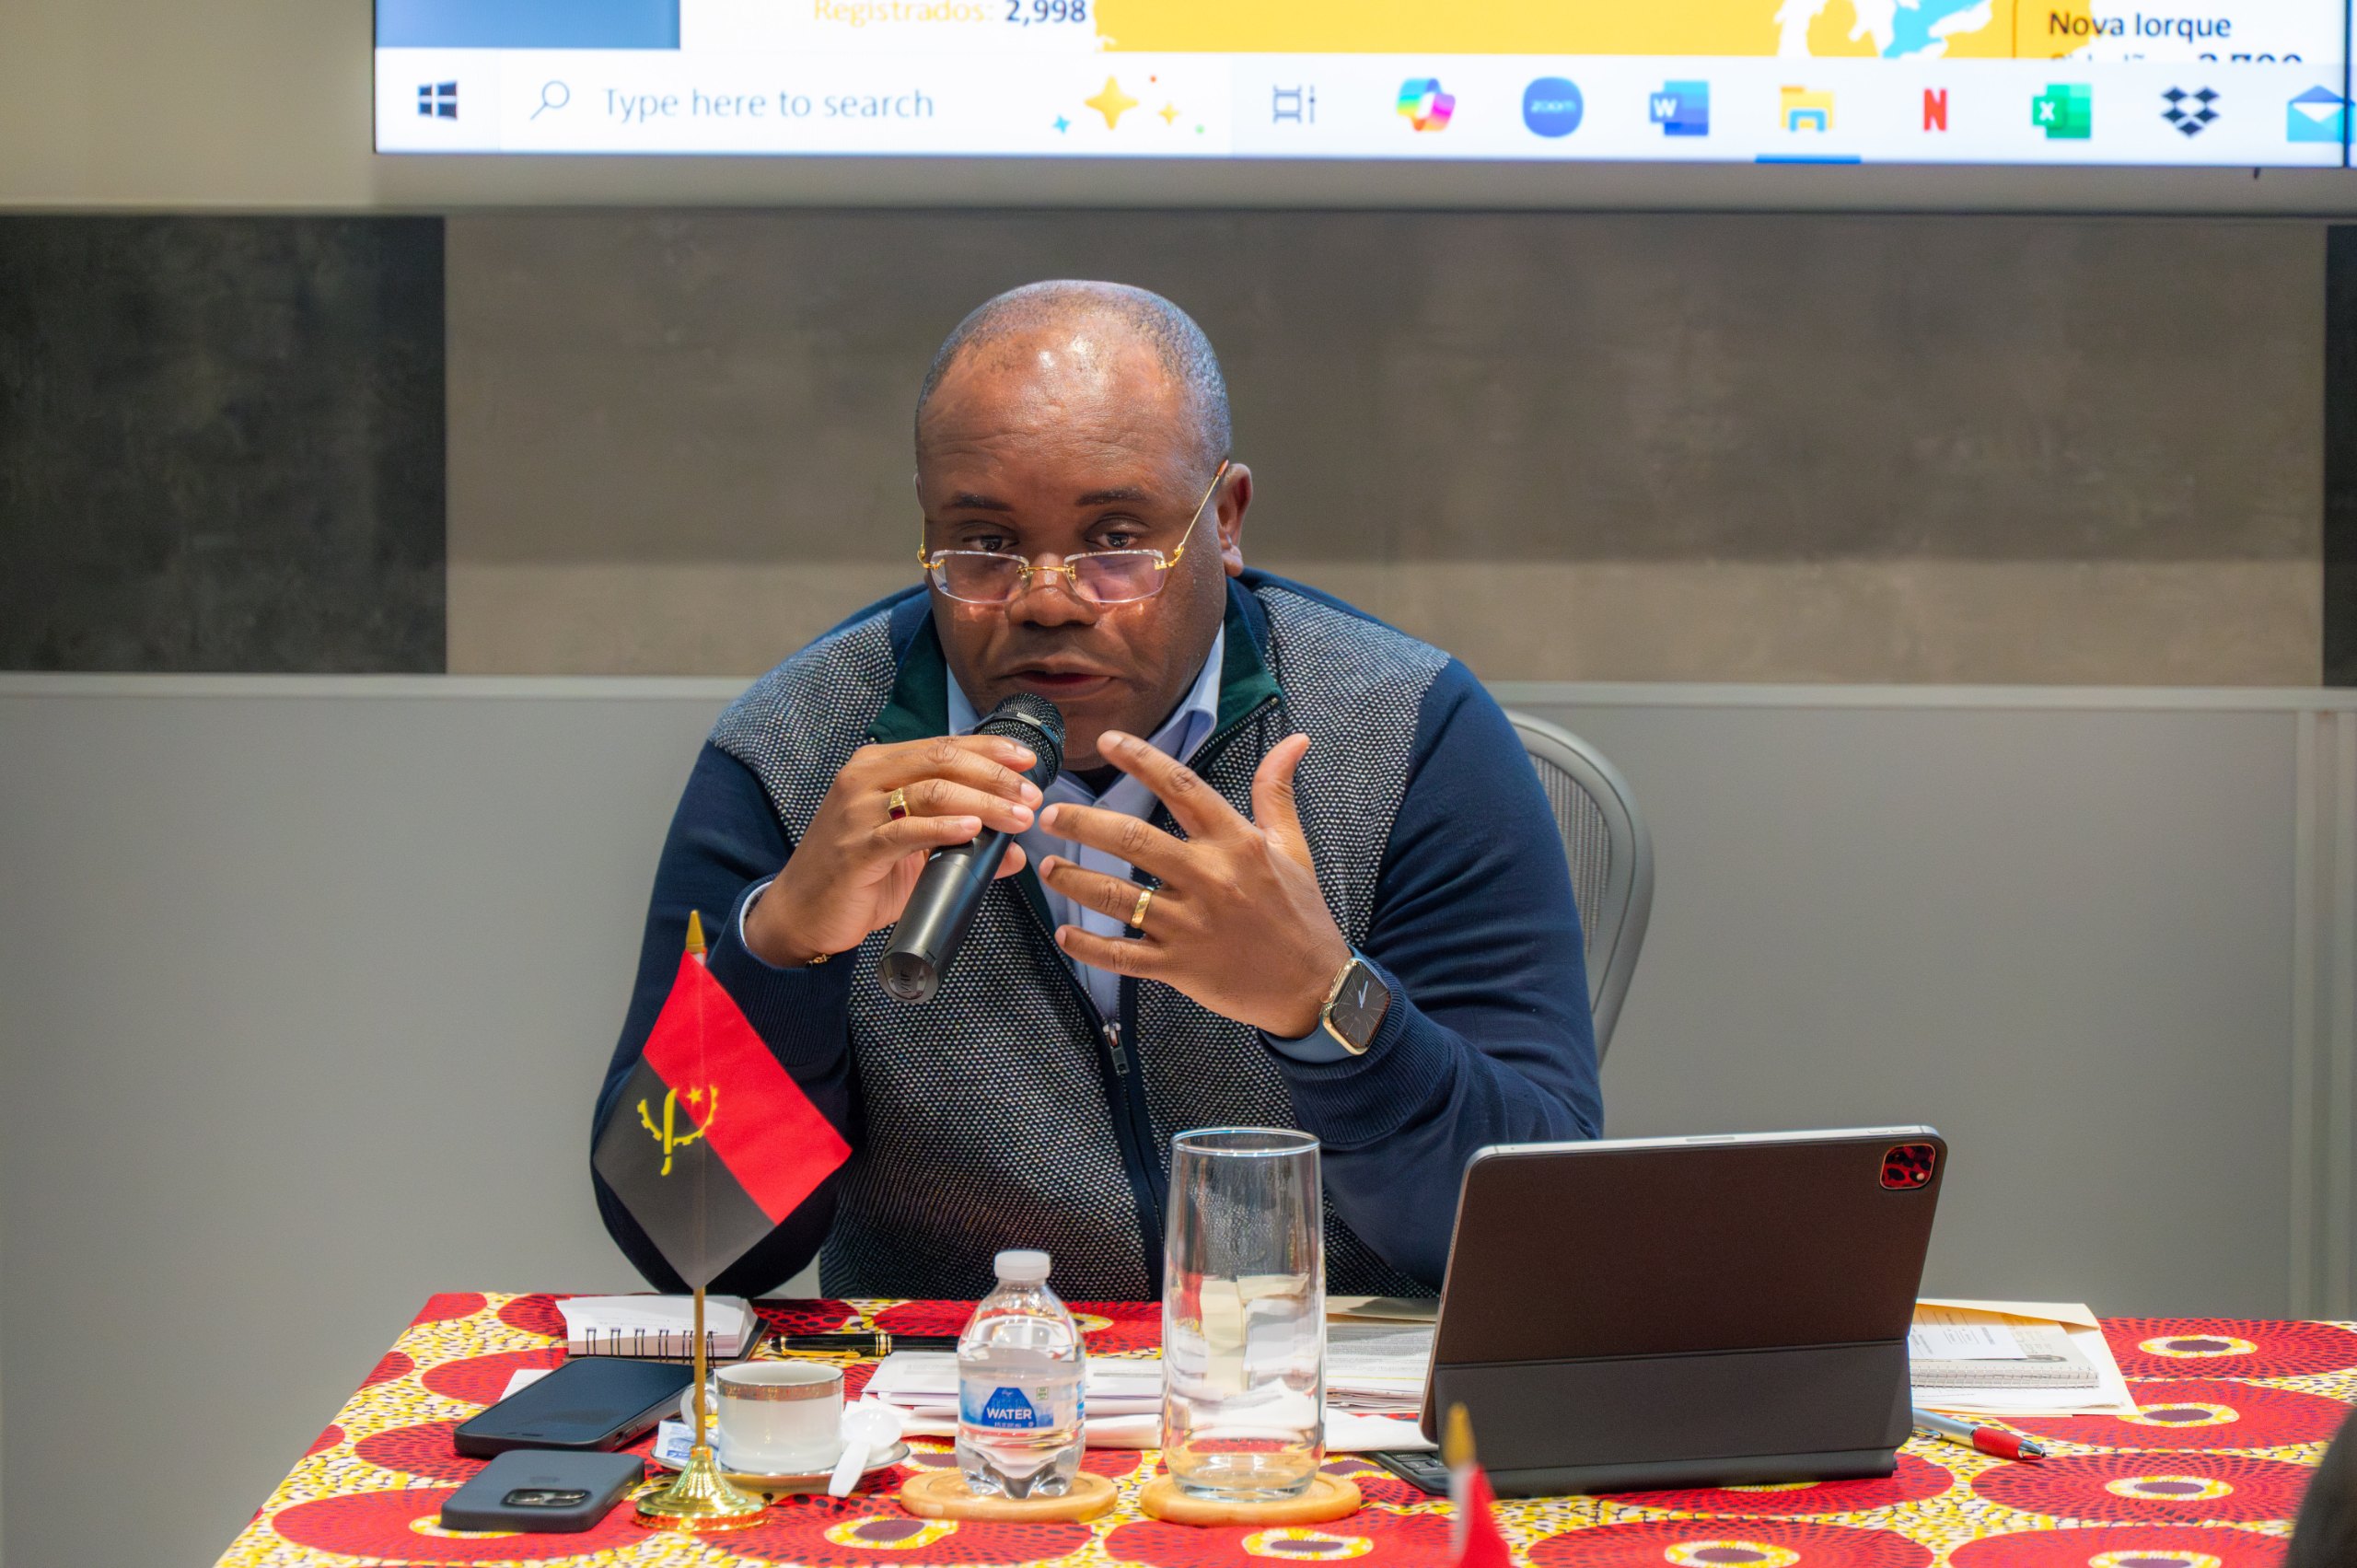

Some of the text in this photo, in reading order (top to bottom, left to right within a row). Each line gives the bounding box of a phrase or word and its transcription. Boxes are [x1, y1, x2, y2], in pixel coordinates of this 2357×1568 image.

[814, 0, 1086, 27] Registrados: 2,998
[2049, 12, 2232, 43] Nova Iorque
[604, 88, 934, 123] Type here to search
[1530, 99, 1576, 113] zoom
[1654, 99, 1677, 117] W
[1923, 89, 1947, 131] N
[986, 1407, 1033, 1420] WATER
